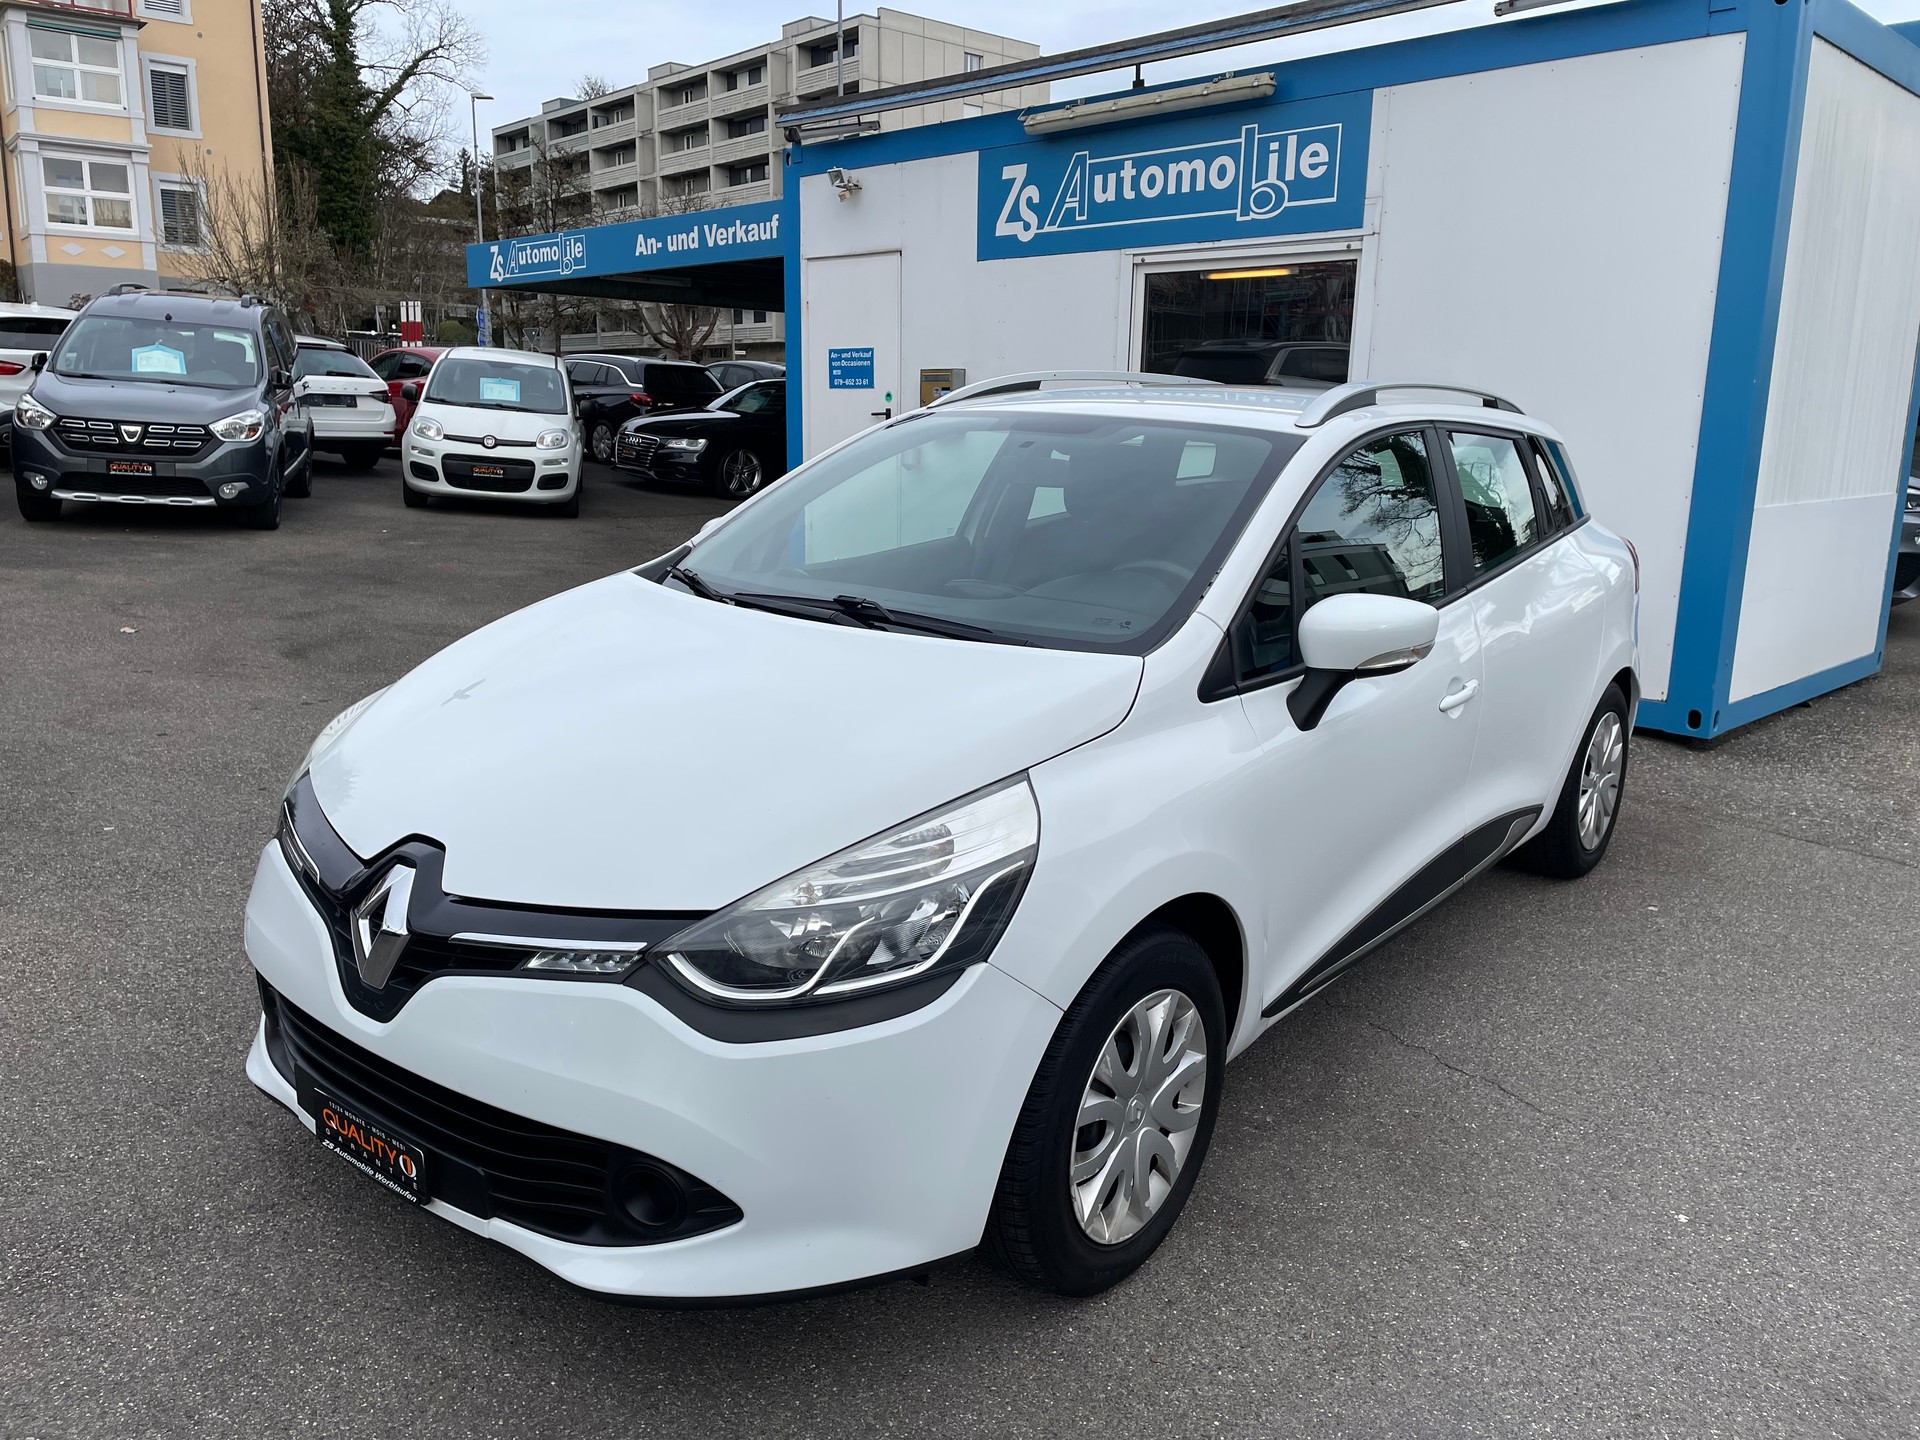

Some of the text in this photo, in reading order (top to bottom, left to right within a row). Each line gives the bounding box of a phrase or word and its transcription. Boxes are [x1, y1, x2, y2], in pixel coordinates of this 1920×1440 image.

[1044, 124, 1329, 230] Automobile
[506, 233, 583, 277] Automobile
[635, 213, 780, 257] An- und Verkauf
[841, 359, 871, 367] Occasionen
[322, 1107, 398, 1166] QUALITY
[322, 1139, 418, 1203] ZS Automobile Worblaufen
